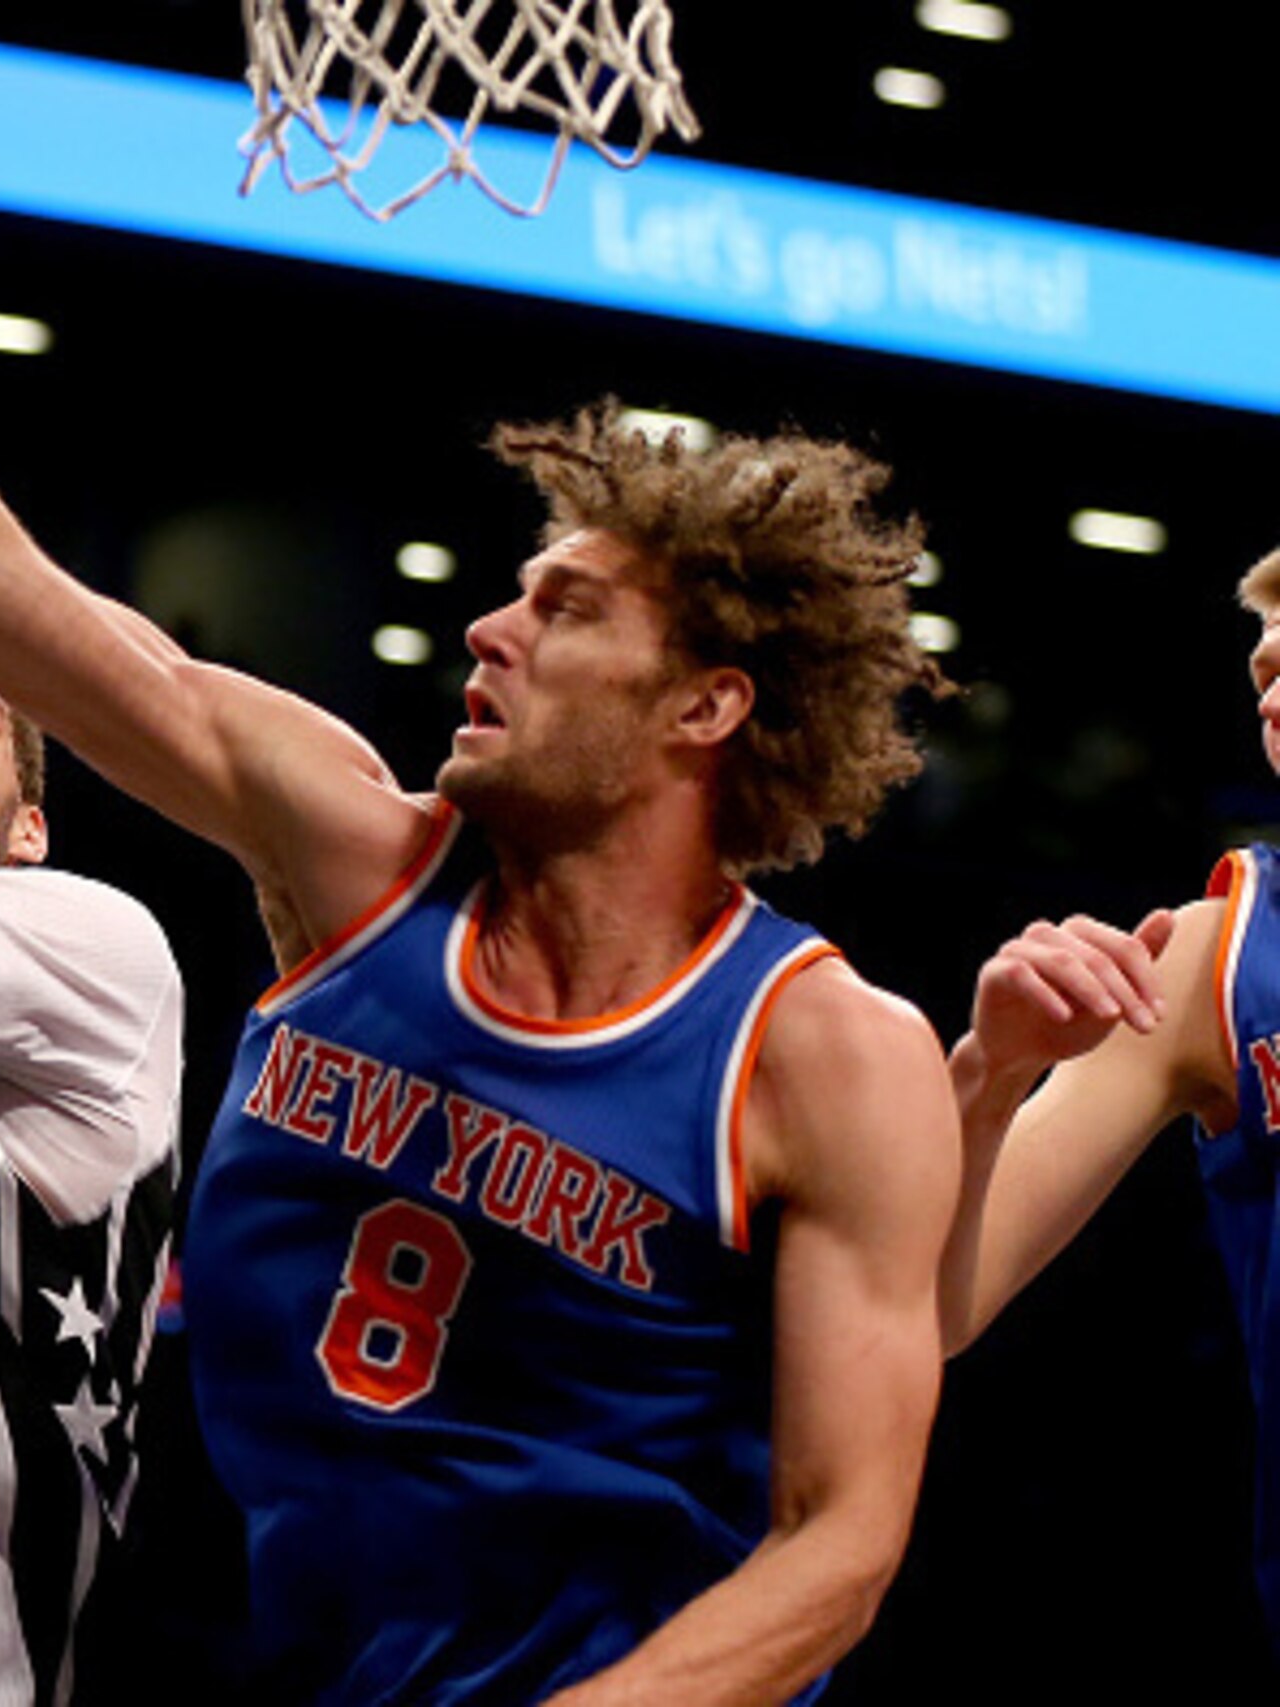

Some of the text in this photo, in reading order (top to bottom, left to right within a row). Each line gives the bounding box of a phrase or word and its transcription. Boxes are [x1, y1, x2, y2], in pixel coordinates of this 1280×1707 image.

[594, 180, 772, 296] Let's
[780, 228, 888, 328] go
[244, 1022, 672, 1291] NEW YORK
[314, 1199, 474, 1412] 8
